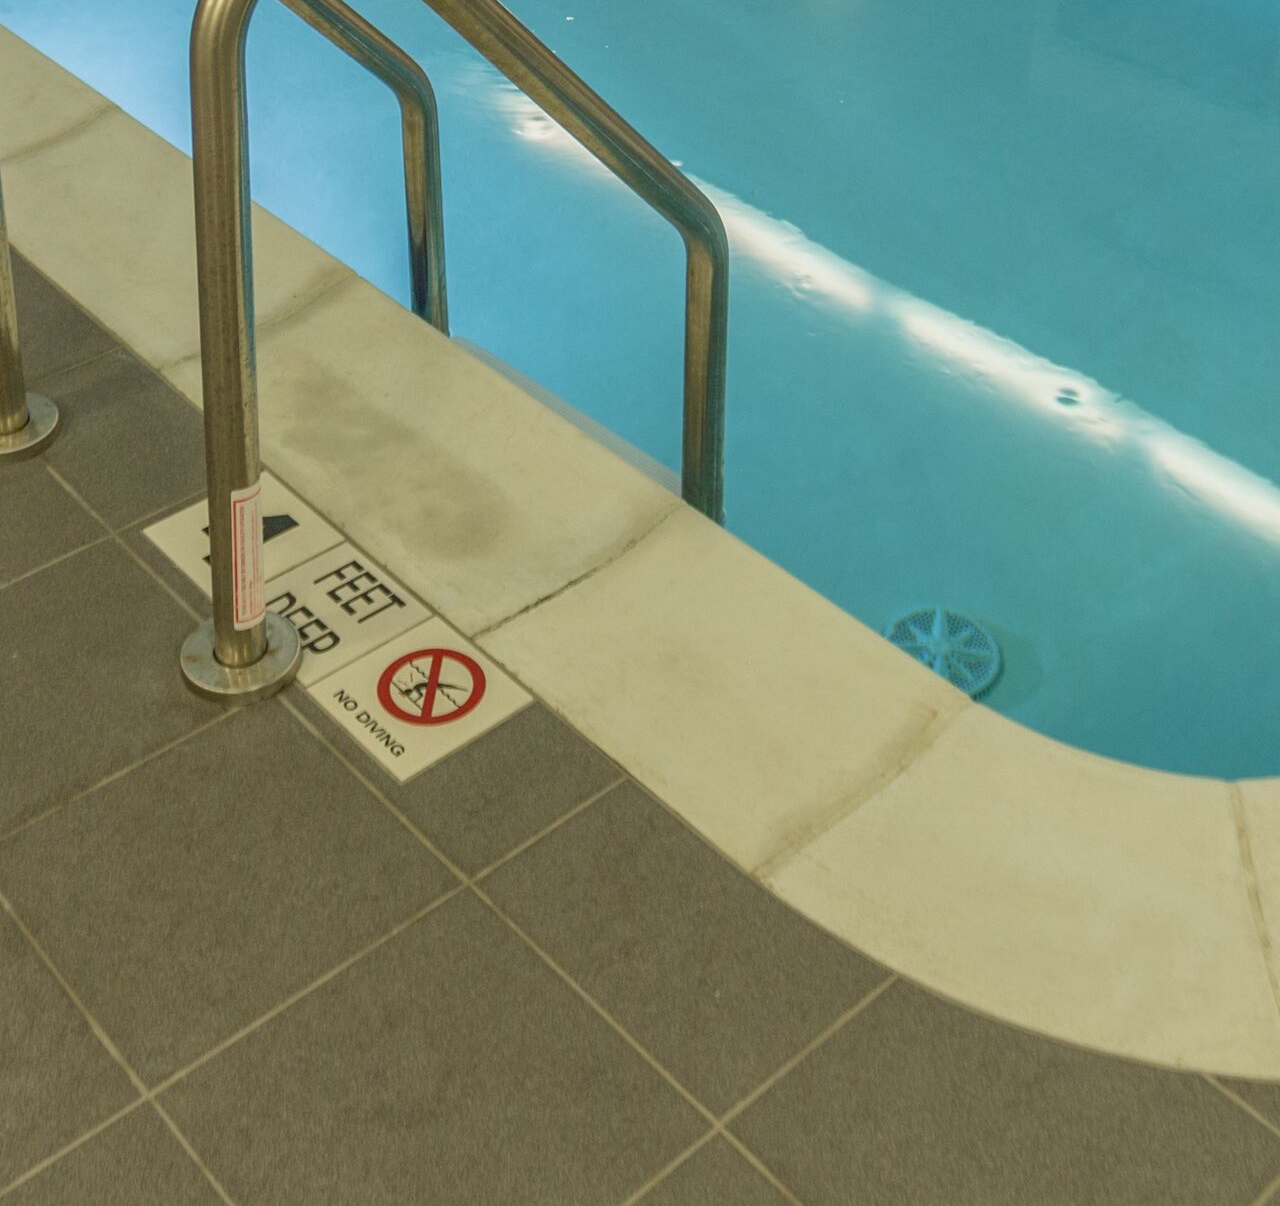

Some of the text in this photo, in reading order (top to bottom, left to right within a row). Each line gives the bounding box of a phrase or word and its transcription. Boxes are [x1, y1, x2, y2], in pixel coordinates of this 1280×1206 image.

[313, 560, 407, 624] FEET
[333, 689, 405, 757] NO DIVING
